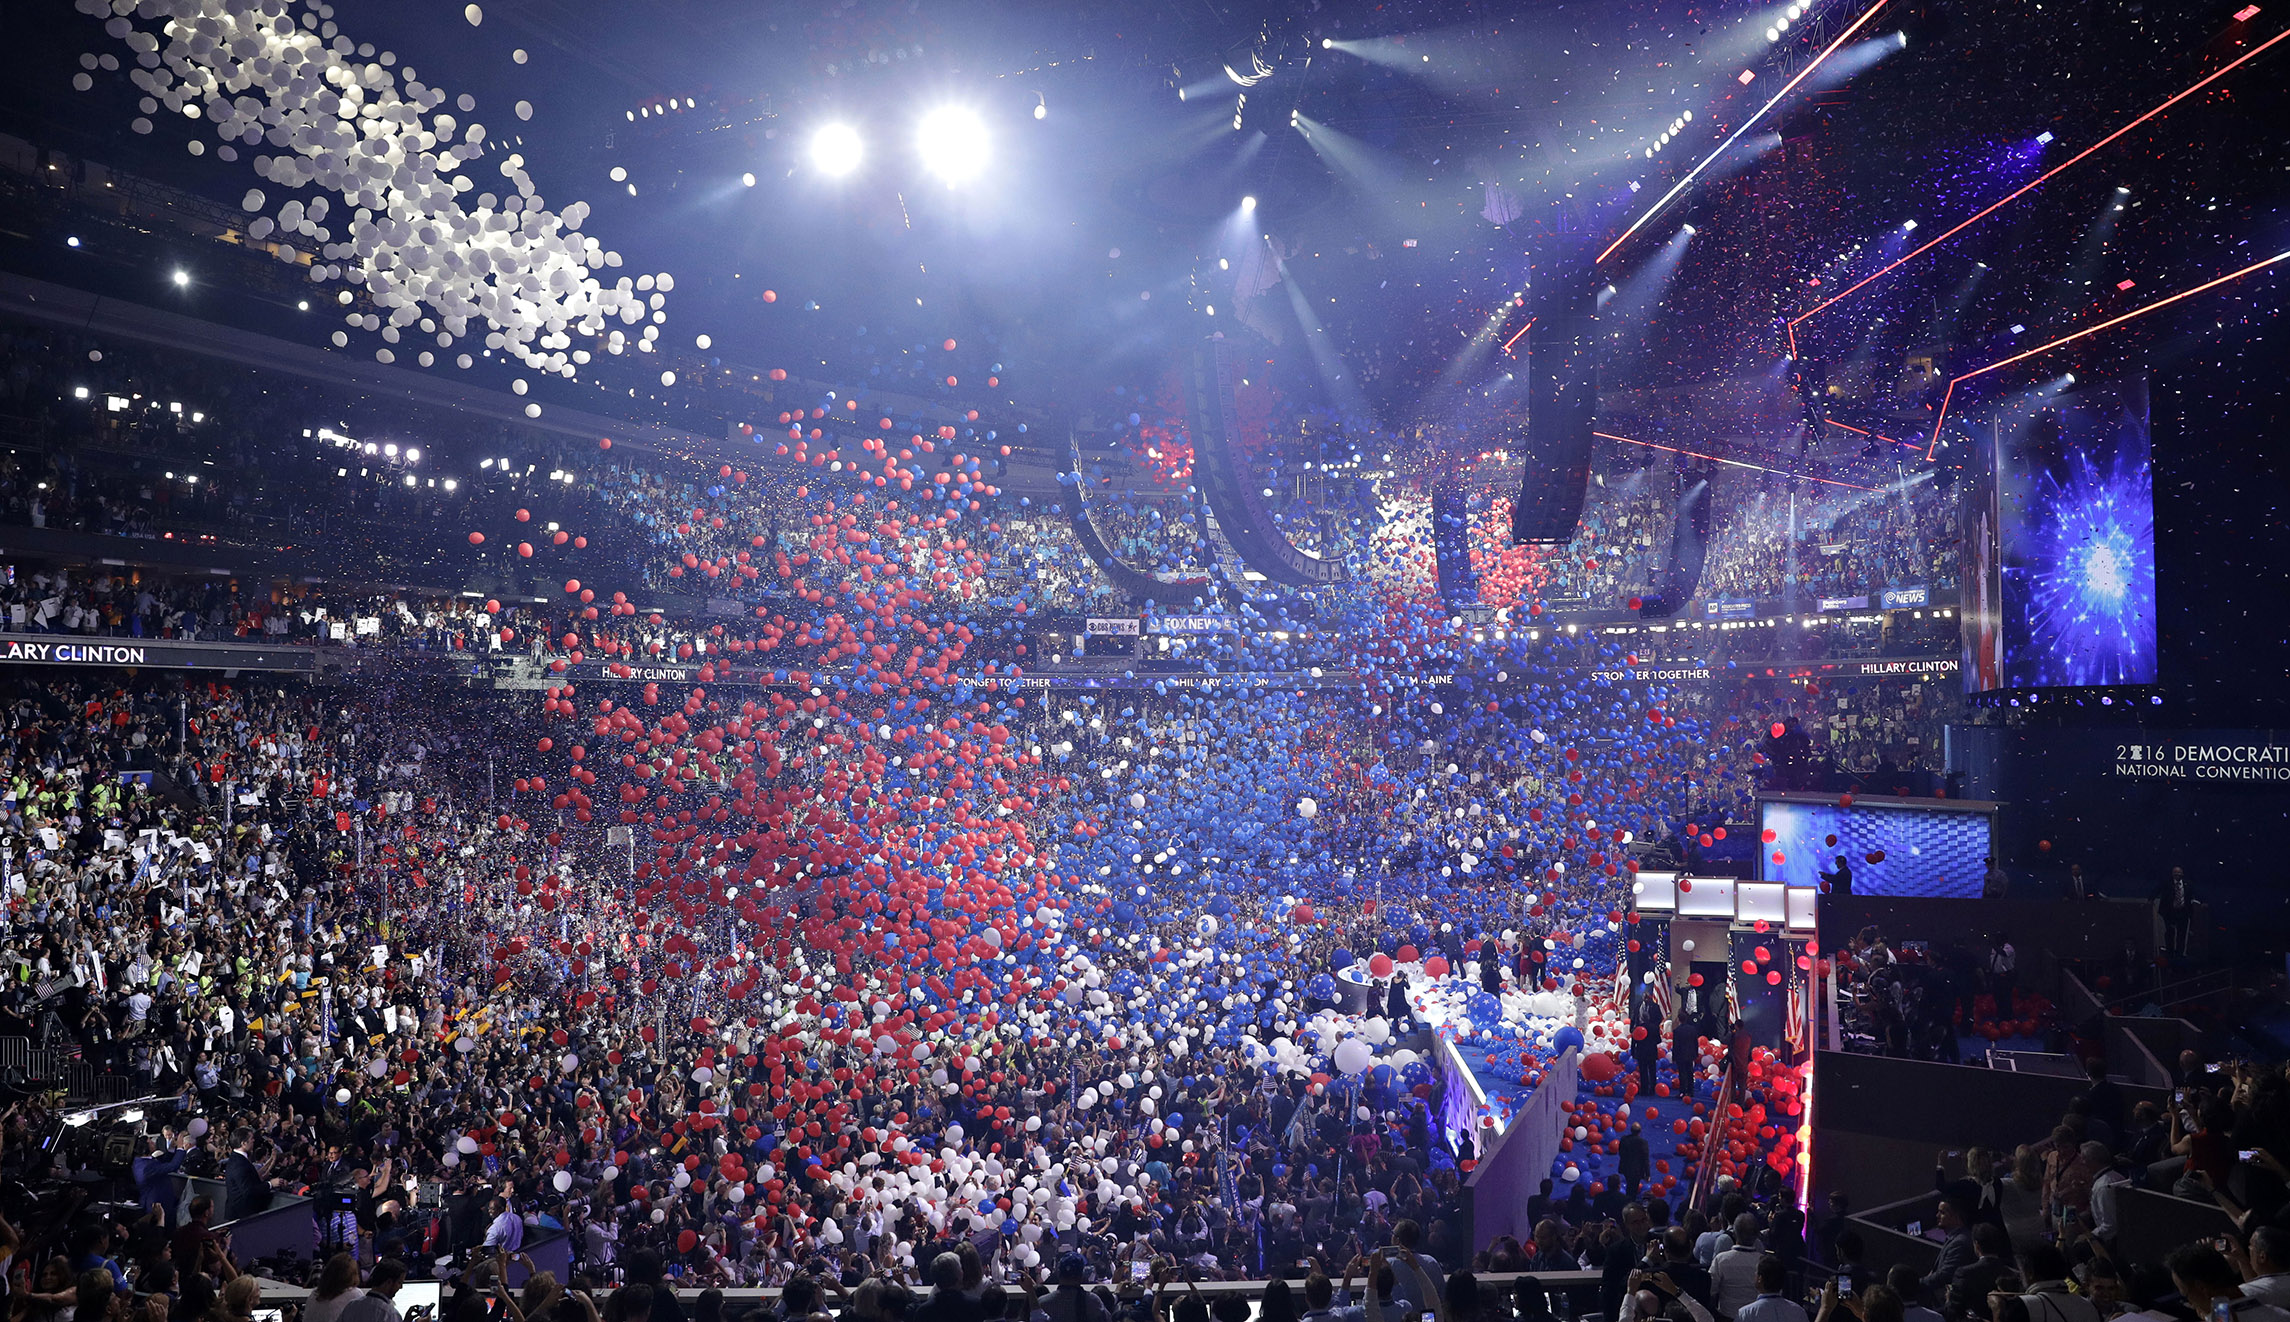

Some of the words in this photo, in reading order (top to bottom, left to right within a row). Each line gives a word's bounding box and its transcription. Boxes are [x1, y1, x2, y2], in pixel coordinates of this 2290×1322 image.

[1896, 593, 1925, 603] NEWS
[1098, 623, 1108, 631] CBS
[1164, 618, 1187, 629] FOX
[55, 644, 144, 663] CLINTON
[602, 666, 643, 678] HILRY
[645, 668, 685, 680] CLINTON
[1861, 662, 1906, 673] HILLARY
[1909, 661, 1958, 672] CLINTON
[1591, 671, 1650, 681] STRONER
[1652, 669, 1710, 680] TOGETHER
[1000, 678, 1051, 687] TOETHER
[2117, 745, 2165, 760] 216
[2175, 746, 2289, 762] DEMOCRATI
[2116, 764, 2187, 777] NATIONAL
[2195, 765, 2290, 780] CONVENTIO
[1217, 1153, 1228, 1202] HILLARY
[1227, 1171, 1242, 1221] HILLARY
